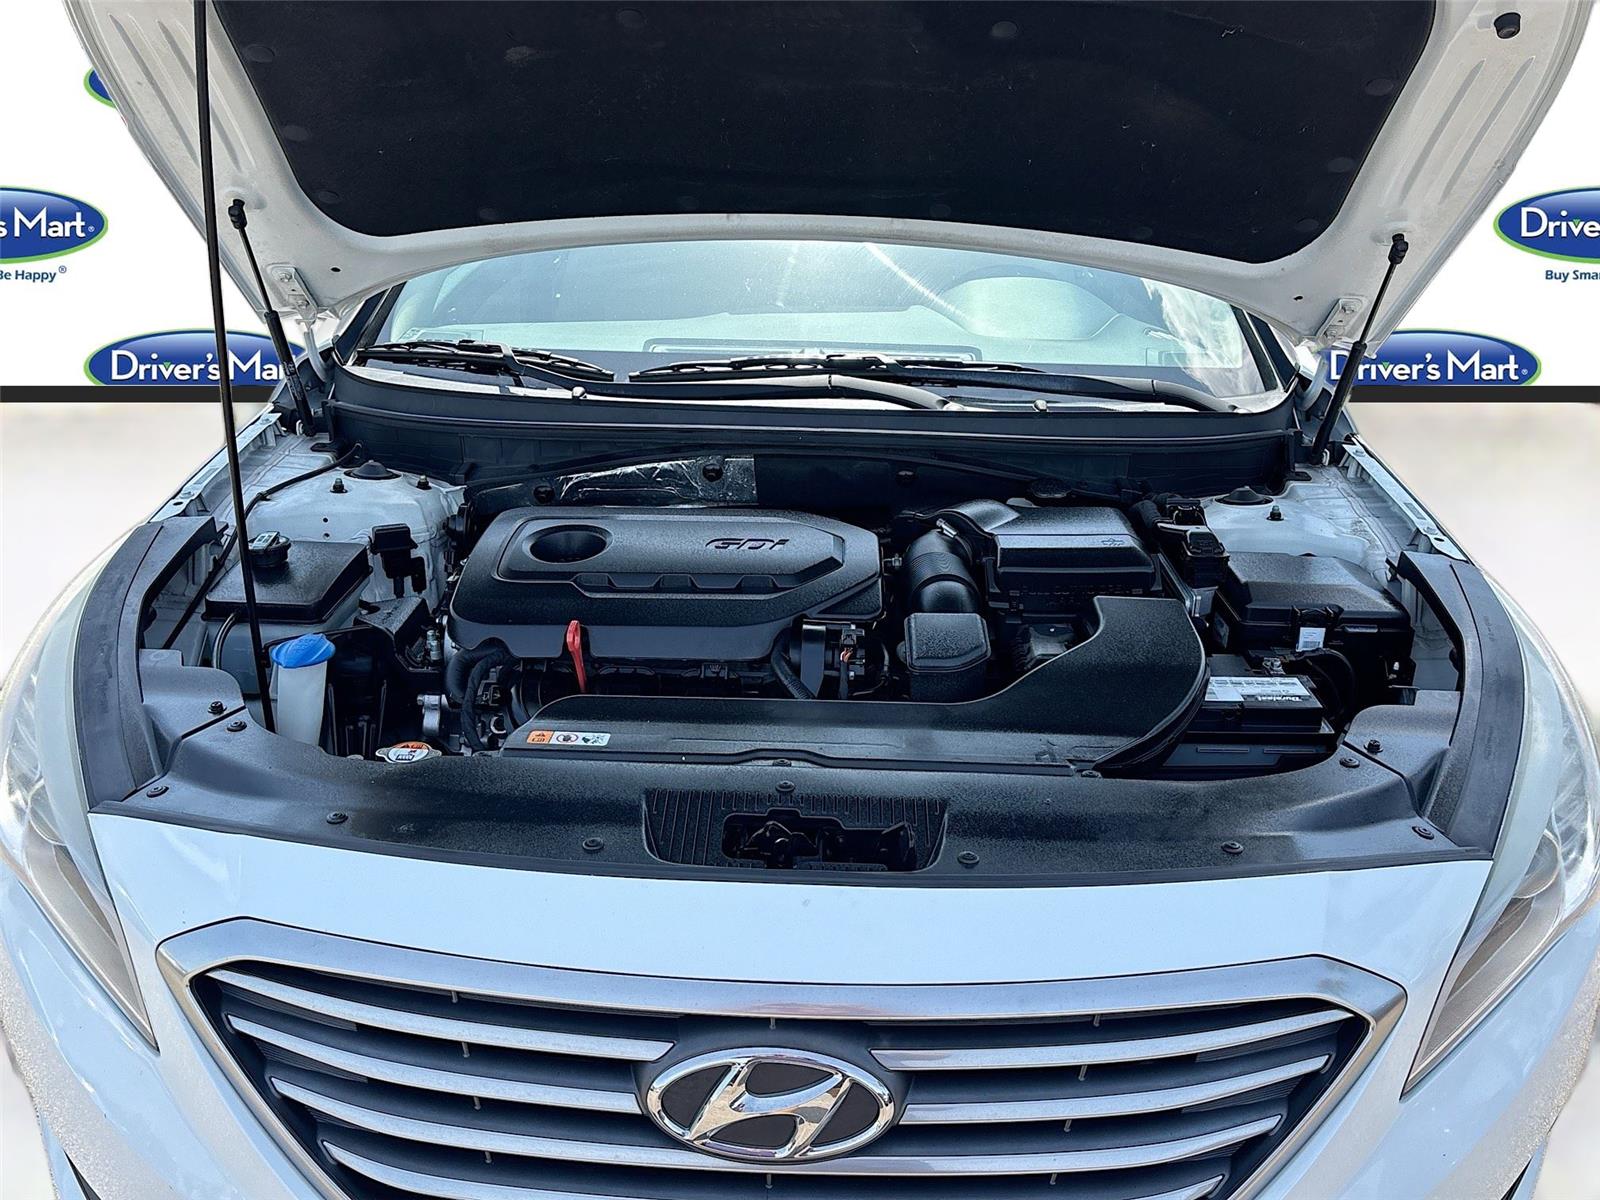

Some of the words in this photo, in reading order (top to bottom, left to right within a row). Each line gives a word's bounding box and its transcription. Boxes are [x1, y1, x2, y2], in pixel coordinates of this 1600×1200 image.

[13, 206, 86, 238] Mart
[1521, 206, 1600, 238] Drive
[14, 269, 57, 283] Happy
[1545, 269, 1570, 283] Buy
[111, 349, 220, 381] Driver's
[1330, 349, 1441, 381] Driver's
[1447, 349, 1519, 381] Mart
